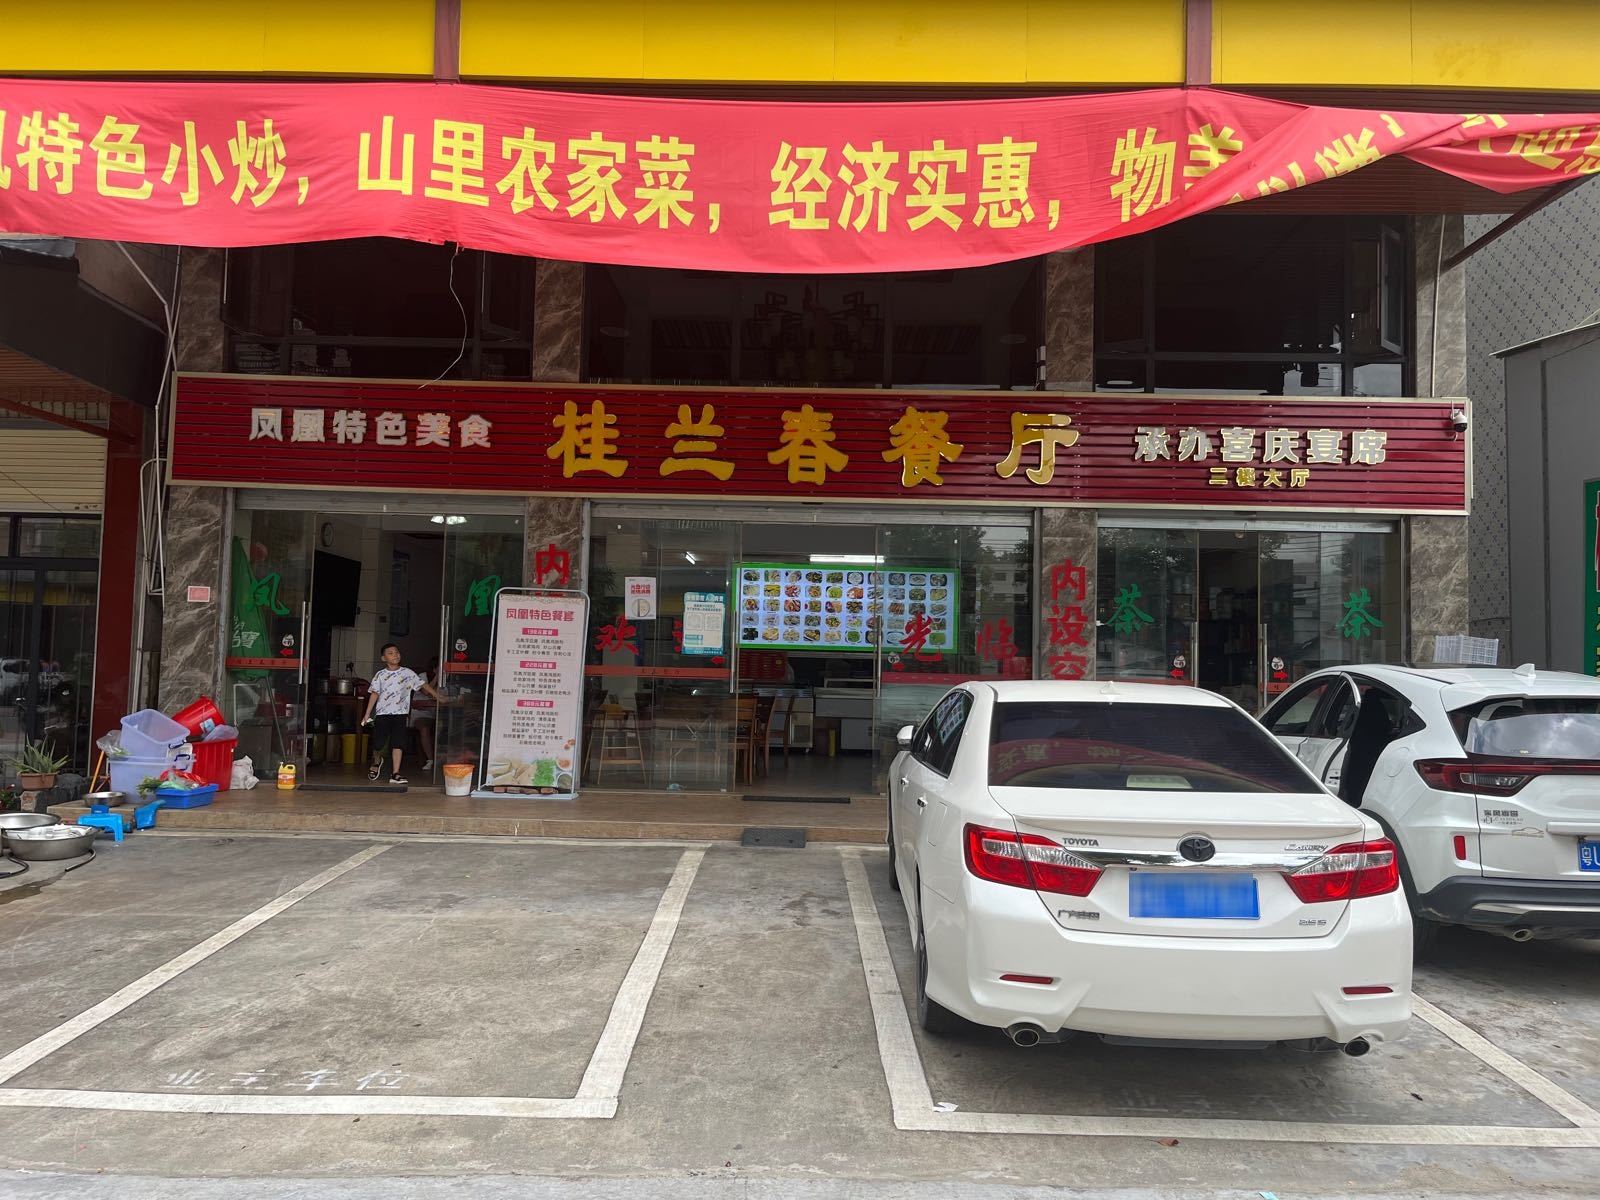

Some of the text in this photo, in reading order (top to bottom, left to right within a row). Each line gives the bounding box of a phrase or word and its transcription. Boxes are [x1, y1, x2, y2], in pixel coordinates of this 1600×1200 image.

[248, 407, 493, 449] 凤凰特色美食
[546, 399, 1081, 488] 桂兰春餐厅
[1133, 426, 1389, 467] 承办喜庆宴席
[1104, 583, 1156, 637] 茶
[1334, 587, 1386, 640] 茶
[1062, 837, 1099, 848] TOYOTA
